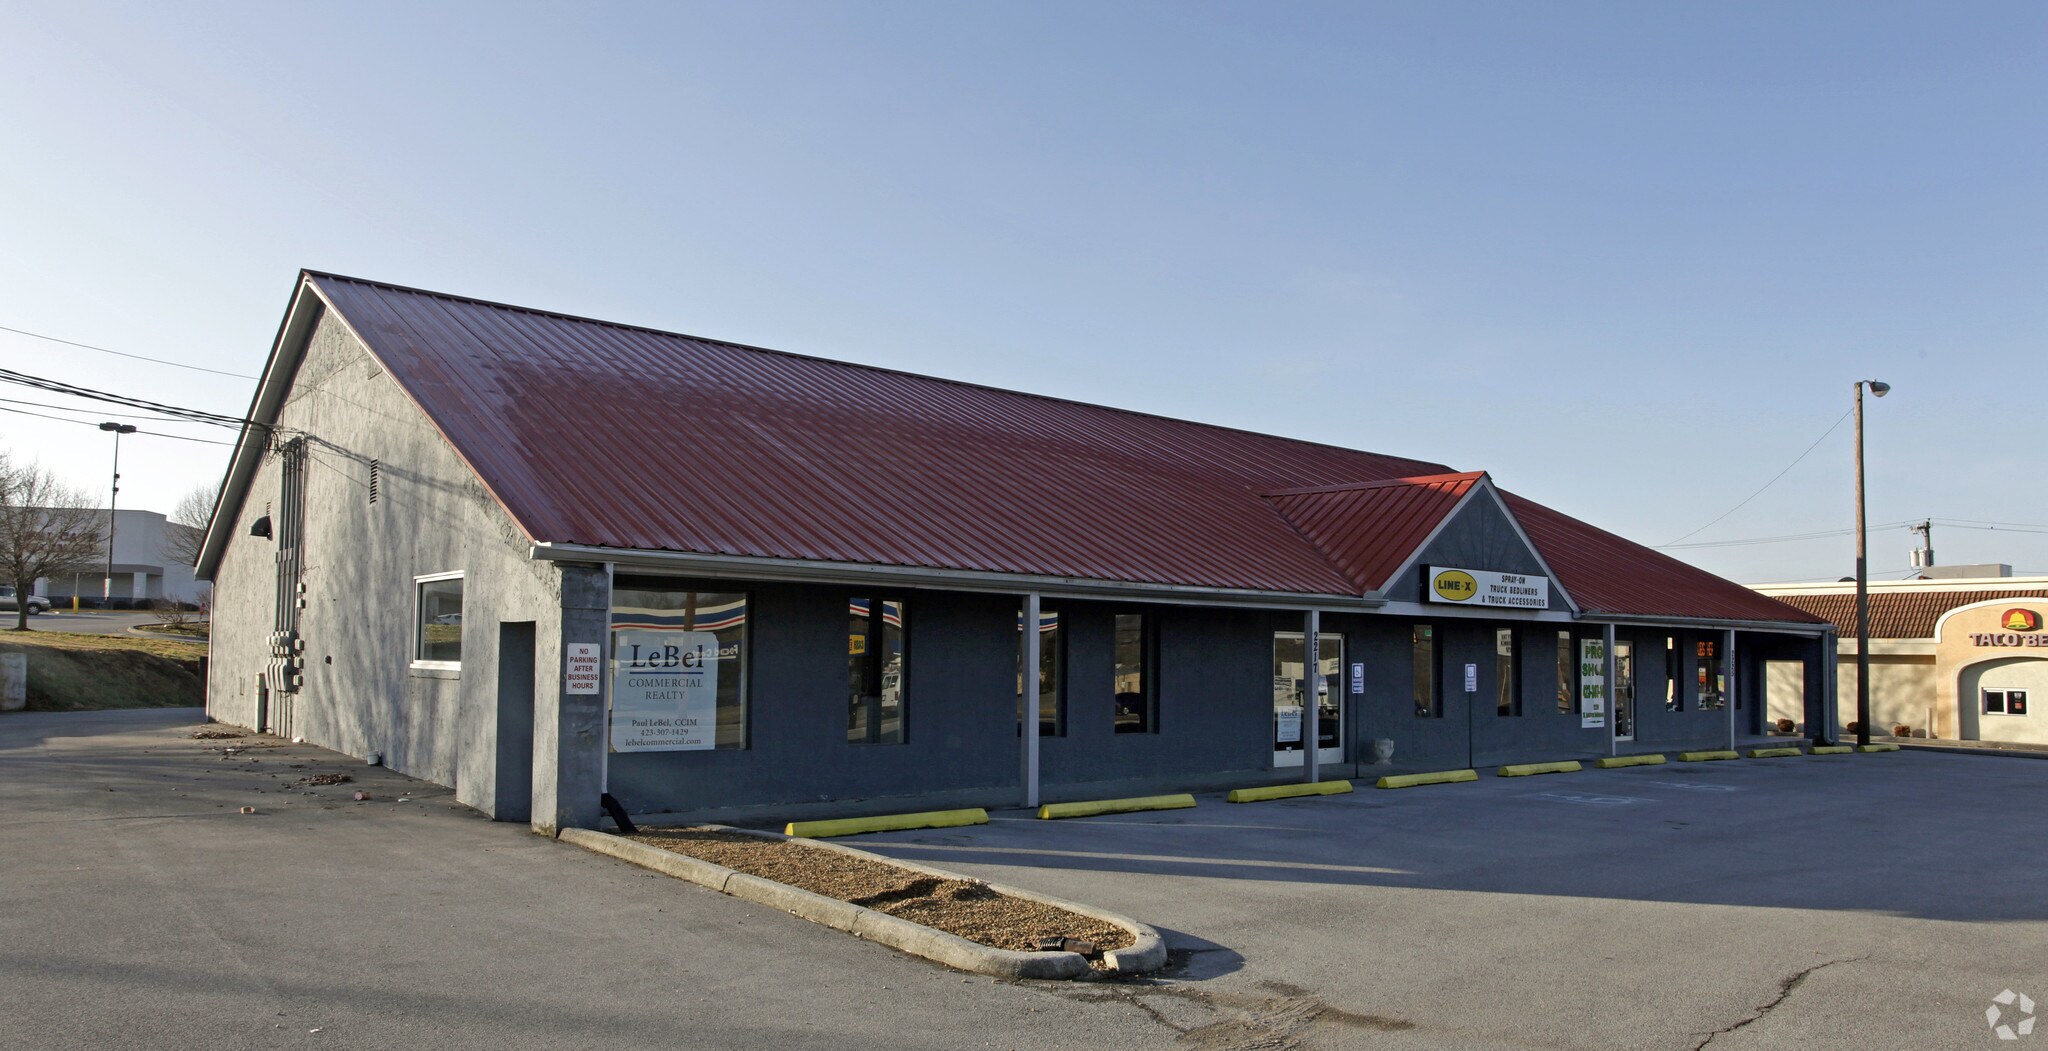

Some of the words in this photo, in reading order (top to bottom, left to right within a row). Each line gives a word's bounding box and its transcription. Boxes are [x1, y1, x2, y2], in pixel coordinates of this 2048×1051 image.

[1501, 575, 1526, 584] SPRAY-ON
[1437, 579, 1472, 592] LINE-X
[1490, 584, 1508, 594] TRUCK
[1509, 586, 1538, 596] BEDLINERS
[1488, 596, 1507, 605] TRUCK
[1508, 597, 1545, 607] ACCESSORIES
[1969, 632, 2019, 646] TACO
[569, 656, 598, 664] PARKING
[630, 644, 704, 668] LeBel
[567, 673, 599, 681] BUSINESS
[628, 678, 703, 688] COMMERCIAL
[645, 691, 686, 700] REALTY
[631, 719, 648, 727] Paul
[649, 719, 672, 728] LeBel,
[625, 738, 702, 747] lebelcommercial.com
